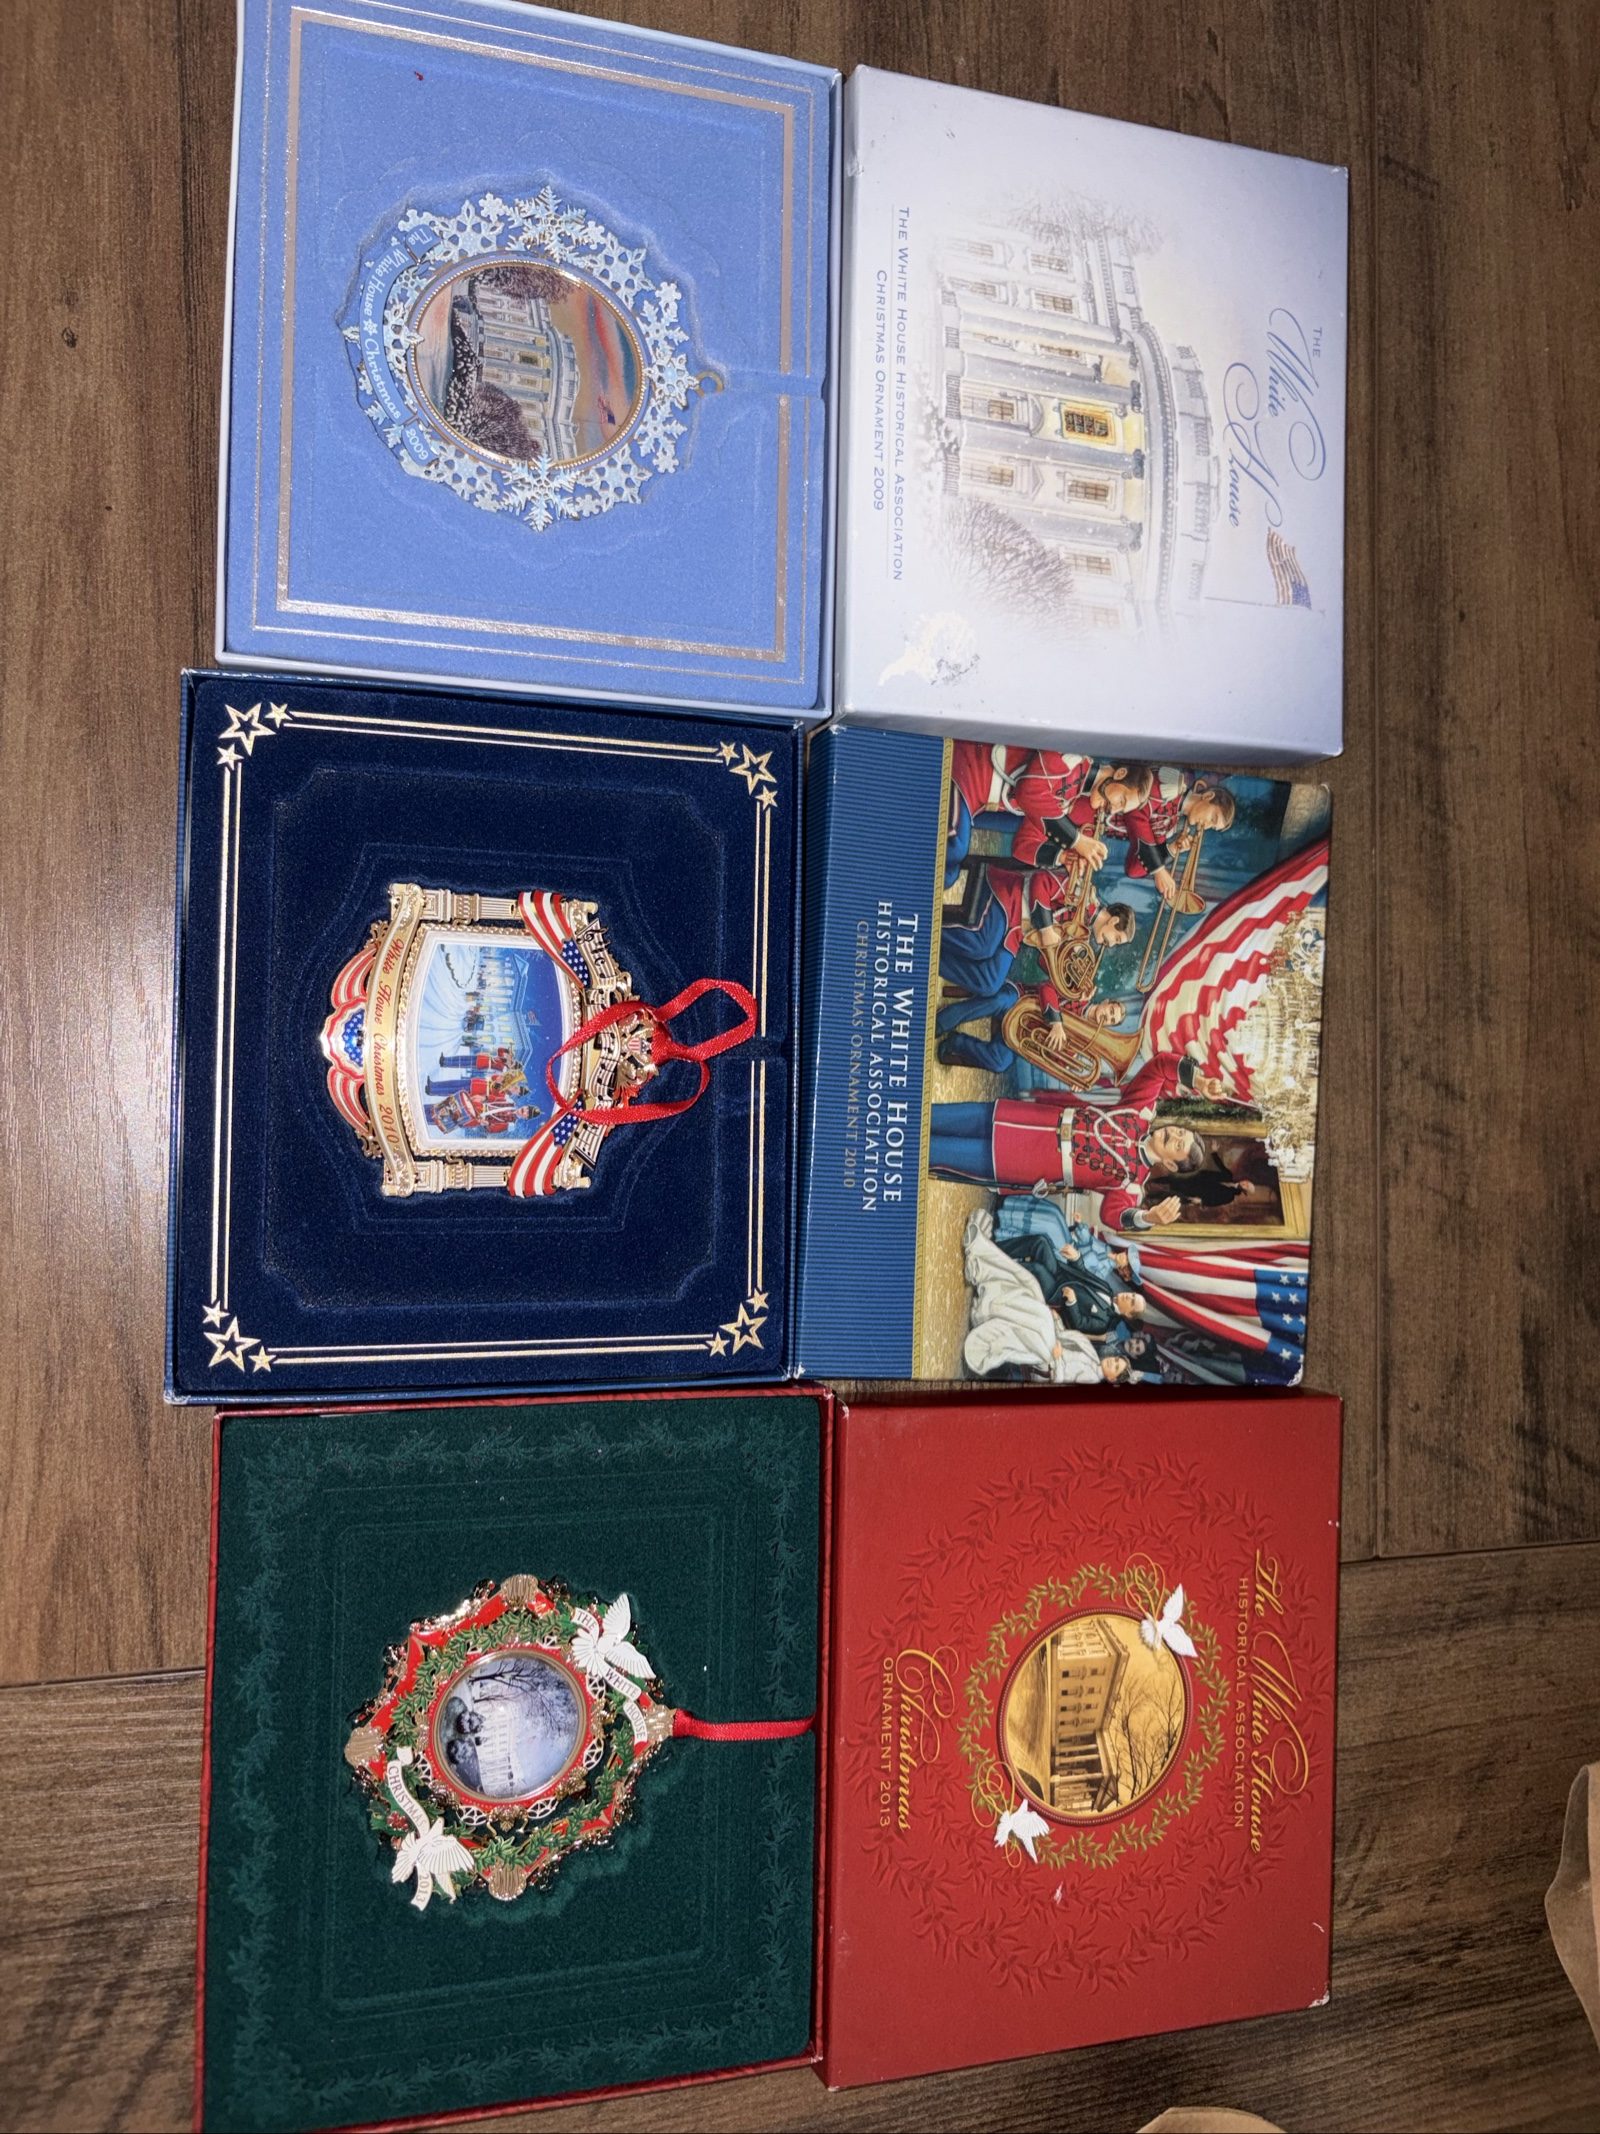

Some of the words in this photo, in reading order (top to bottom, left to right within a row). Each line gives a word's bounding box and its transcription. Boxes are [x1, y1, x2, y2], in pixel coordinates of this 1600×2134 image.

[374, 248, 407, 276] White
[407, 228, 432, 246] The
[898, 206, 910, 240] THE
[364, 276, 385, 316] House
[875, 269, 887, 363] CHRISTMAS
[896, 247, 909, 301] WHITE
[364, 338, 402, 420] Christmas
[896, 308, 907, 365] HOUSE
[1312, 327, 1322, 357] THE
[874, 370, 886, 462] ORNAMENT
[894, 371, 907, 467] HISTORICAL
[1266, 308, 1326, 481] White
[406, 428, 428, 460] 2009
[873, 467, 885, 511] 2009
[1223, 362, 1283, 528] House
[893, 474, 905, 581] ASSOCIATION
[382, 938, 405, 974] White
[851, 920, 869, 1027] CHRISTMAS
[869, 901, 892, 1043] HISTORICAL
[894, 913, 918, 974] THE
[374, 981, 392, 1024] House
[888, 988, 914, 1088] WHITE
[373, 1032, 387, 1096] Christmas
[846, 1034, 864, 1141] ORNAMENT
[379, 1104, 399, 1144] 2010
[842, 1148, 857, 1188] 2010
[861, 1052, 884, 1212] ASSOCIATION
[882, 1101, 908, 1203] HOUSE
[1254, 1549, 1284, 1617] The
[576, 1611, 596, 1631] THE
[604, 1667, 639, 1699] WHITE
[626, 1704, 647, 1739] HOUSE
[1236, 1577, 1249, 1692] HISTORICAL
[880, 1657, 893, 1772] ORNAMENT
[895, 1646, 960, 1832] Christmas
[1249, 1631, 1308, 1795] White
[879, 1780, 892, 1827] 2013
[1234, 1700, 1246, 1828] ASSOCIATION
[1249, 1750, 1274, 1854] House
[388, 1765, 426, 1828] CHRISTMAS
[416, 1874, 431, 1903] 2013
